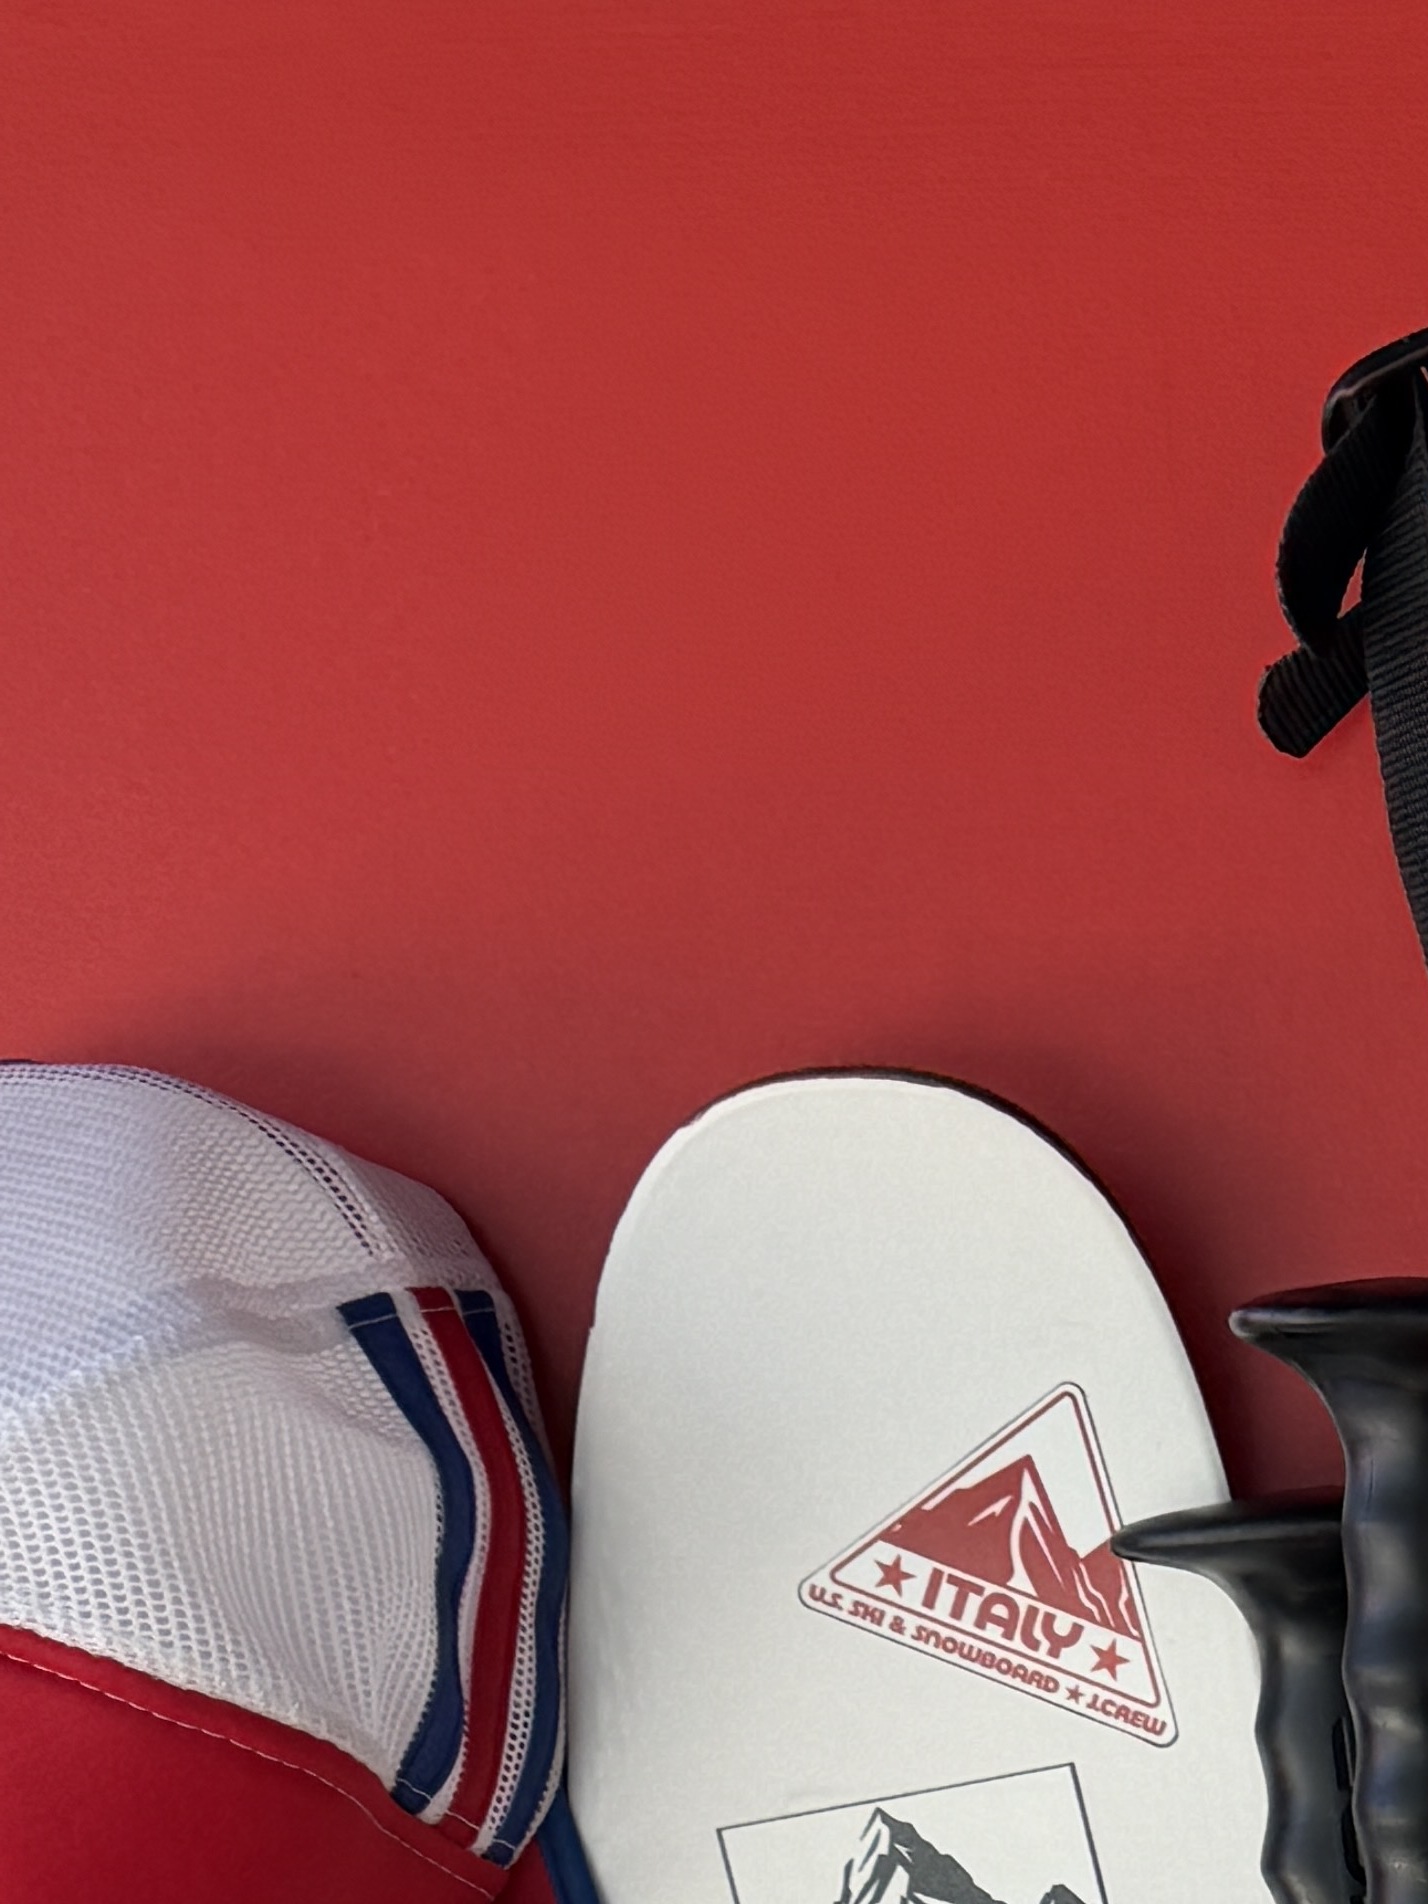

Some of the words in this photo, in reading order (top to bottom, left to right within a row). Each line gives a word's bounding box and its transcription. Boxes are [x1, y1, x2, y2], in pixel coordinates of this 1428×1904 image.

[808, 1583, 844, 1612] U.S.
[848, 1601, 885, 1627] SKI
[888, 1615, 907, 1636] &
[910, 1624, 1061, 1694] SNOWBOARD
[921, 1567, 1085, 1660] ITALY
